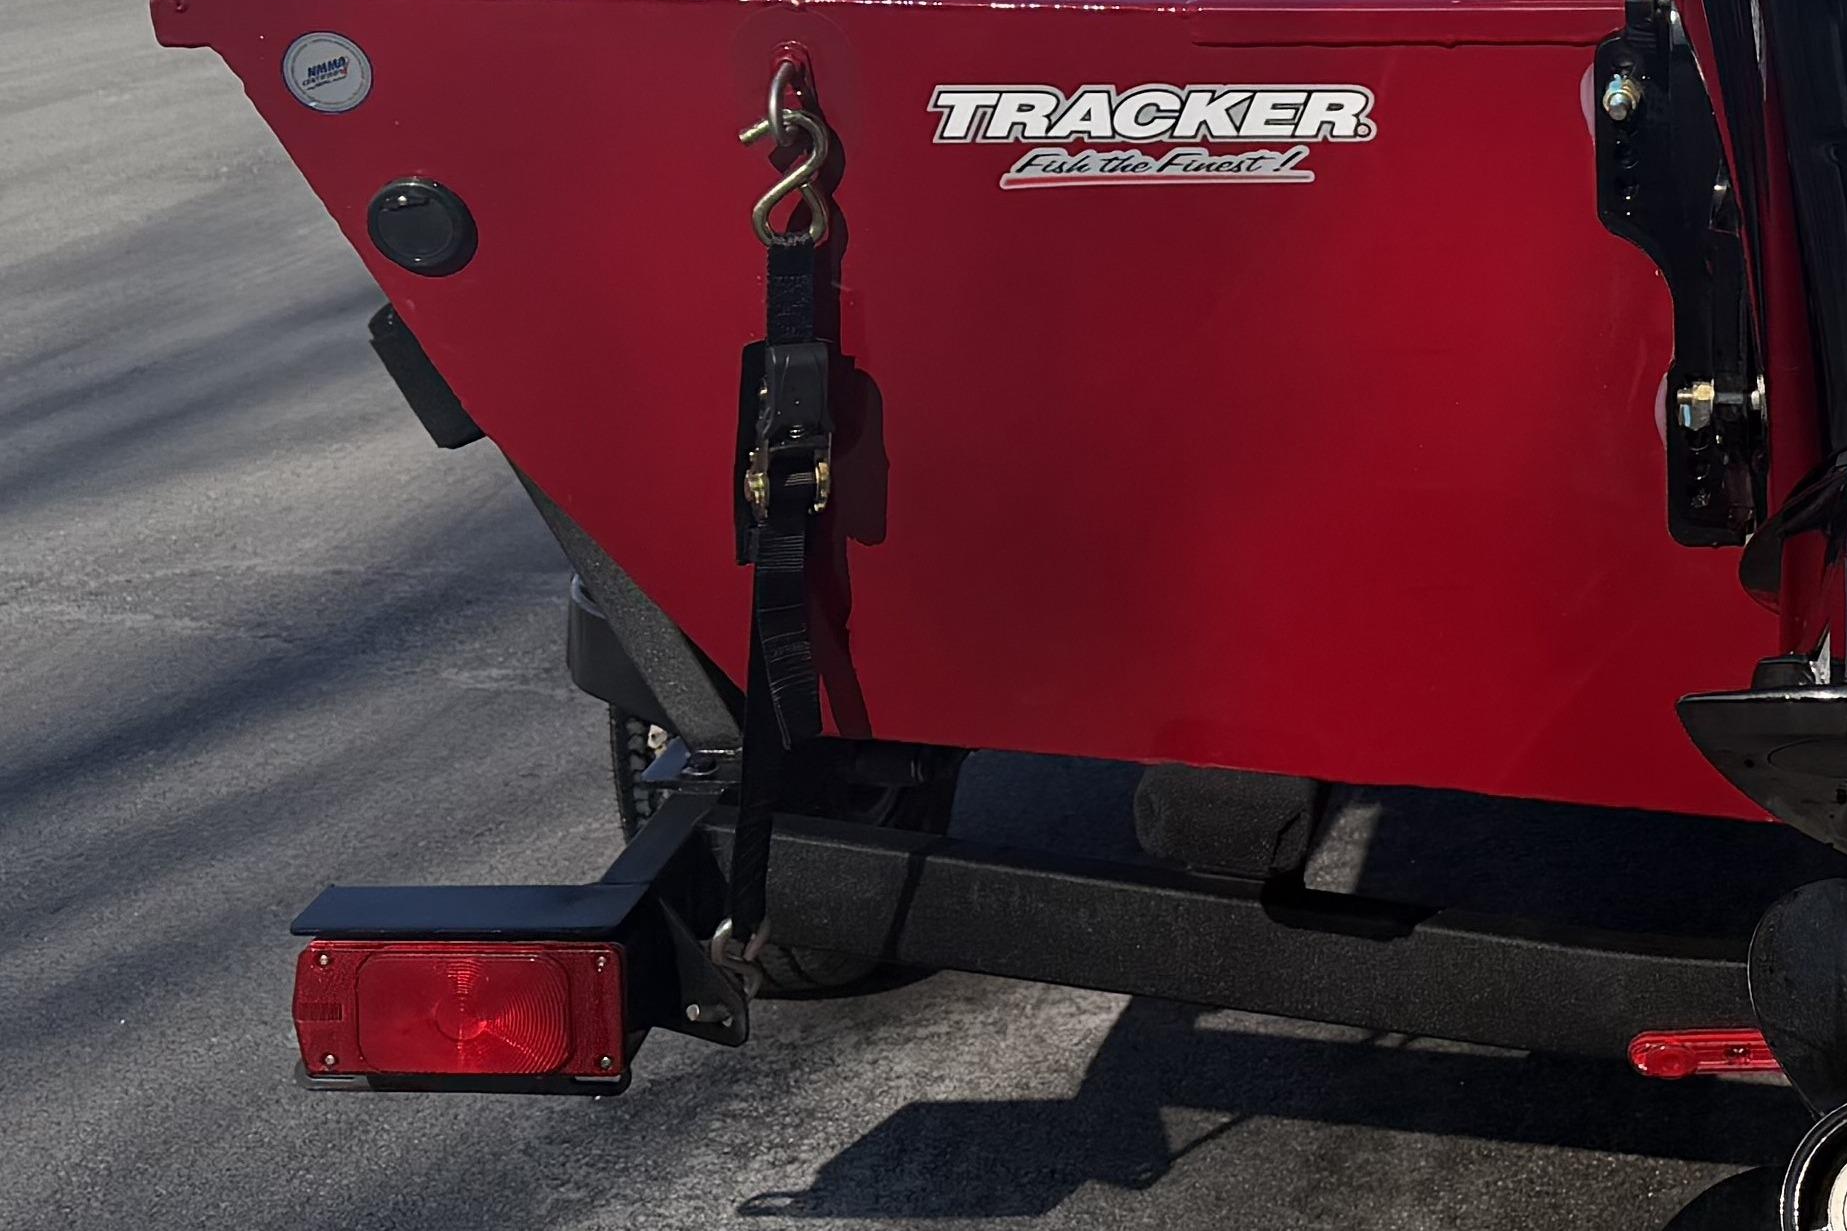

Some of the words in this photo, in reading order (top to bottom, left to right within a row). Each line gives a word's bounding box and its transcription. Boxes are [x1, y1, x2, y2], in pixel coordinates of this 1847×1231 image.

[932, 89, 1371, 139] TRACKER
[1014, 151, 1092, 174] Fish
[1098, 153, 1152, 174] the
[1155, 152, 1263, 174] Finest
